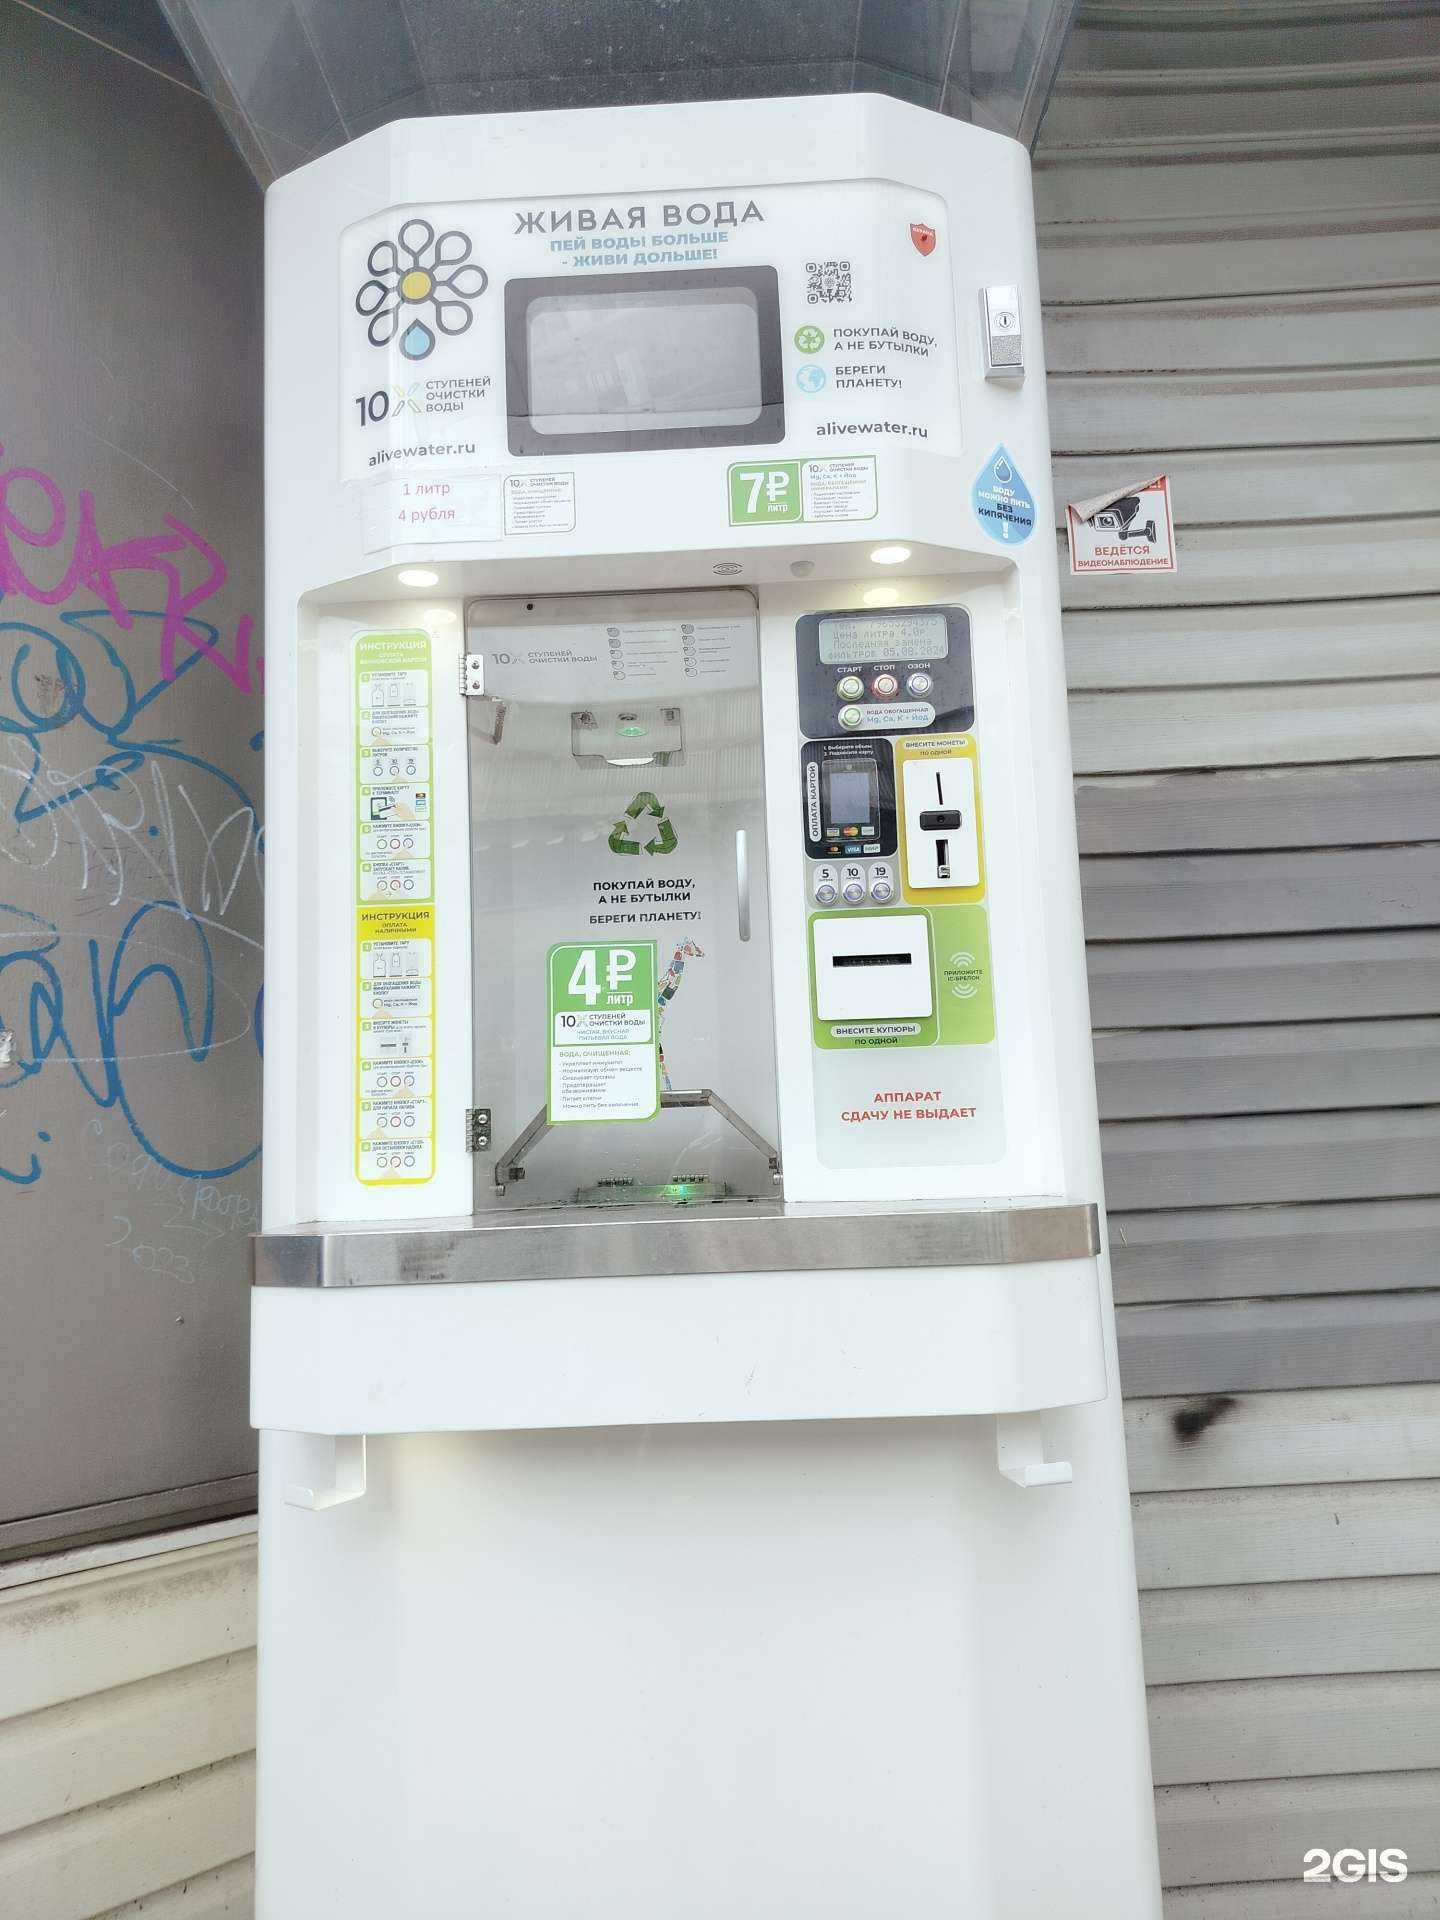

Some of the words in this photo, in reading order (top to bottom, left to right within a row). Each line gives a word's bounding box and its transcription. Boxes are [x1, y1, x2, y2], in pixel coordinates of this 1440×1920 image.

[514, 206, 646, 234] ЖИВАЯ
[663, 200, 765, 228] ВОДА
[550, 236, 586, 252] ПЕЙ
[591, 235, 646, 250] ВОДЫ
[651, 231, 729, 247] БОЛЬШЕ
[573, 254, 628, 267] ЖИВИ
[633, 249, 718, 266] ДОЛЬШЕ!
[834, 326, 899, 338] ПОКУПАЙ
[902, 331, 937, 348] ВОДУ,
[834, 341, 843, 351] А
[848, 341, 865, 350] НЕ
[869, 340, 929, 357] БУТЫЛКИ
[836, 365, 886, 376] БЕРЕГИ
[426, 375, 491, 390] СТУПЕНЕЙ
[836, 379, 902, 389] ПЛАНЕТУ!
[426, 389, 486, 401] ОЧИСТКИ
[426, 402, 464, 413] ВОДЫ
[816, 421, 928, 438] alivewater.ru
[368, 443, 476, 467] alivewater.ru
[403, 483, 411, 496] 1
[415, 483, 451, 497] литр
[992, 486, 1015, 496] ВОДУ
[978, 490, 1009, 503] МОЖНО
[1010, 498, 1031, 509] ПИТЬ
[997, 503, 1013, 513] БЕЗ
[398, 510, 406, 521] 4
[411, 506, 455, 523] рубля
[978, 507, 1032, 527] КИПЯЧЕНИЯ
[1094, 545, 1150, 556] ВЕДЁТСЯ
[1077, 557, 1169, 568] ВИДЕОНАБЛЮДЕНИЕ
[528, 650, 573, 659] СТУПЕНЕЙ
[837, 666, 863, 674] СТАРТ
[873, 664, 896, 672] СТОП
[907, 662, 931, 670] ОЗОН
[936, 739, 966, 747] МОНЕТЫ
[809, 764, 817, 799] КАРТОЙ
[811, 802, 819, 837] ОПЛАТА
[822, 869, 830, 878] 5
[847, 868, 859, 877] 10
[874, 866, 886, 876] 19
[593, 878, 654, 891] ПОКУПАЙ
[658, 878, 696, 890] ВОДУ,
[598, 895, 607, 904] А
[611, 894, 627, 904] НЕ
[631, 891, 691, 903] БУТЫЛКИ
[362, 911, 430, 921] ИНСТРУКЦИЯ
[589, 913, 636, 924] БЕРЕГИ
[639, 911, 701, 922] ПЛАНЕТУ!
[606, 993, 634, 1007] литр
[589, 1012, 626, 1020] СТУПЕНЕЙ
[836, 1026, 875, 1035] ВНЕСИТЕ
[876, 1025, 916, 1034] КУПЮРЫ
[855, 1037, 867, 1045] ПО
[868, 1035, 899, 1046] ОДНОЙ
[874, 1091, 942, 1103] АППАРАТ
[841, 1110, 889, 1122] СДАЧУ
[893, 1109, 911, 1120] НЕ
[916, 1107, 977, 1120] ВЫДАЕТ
